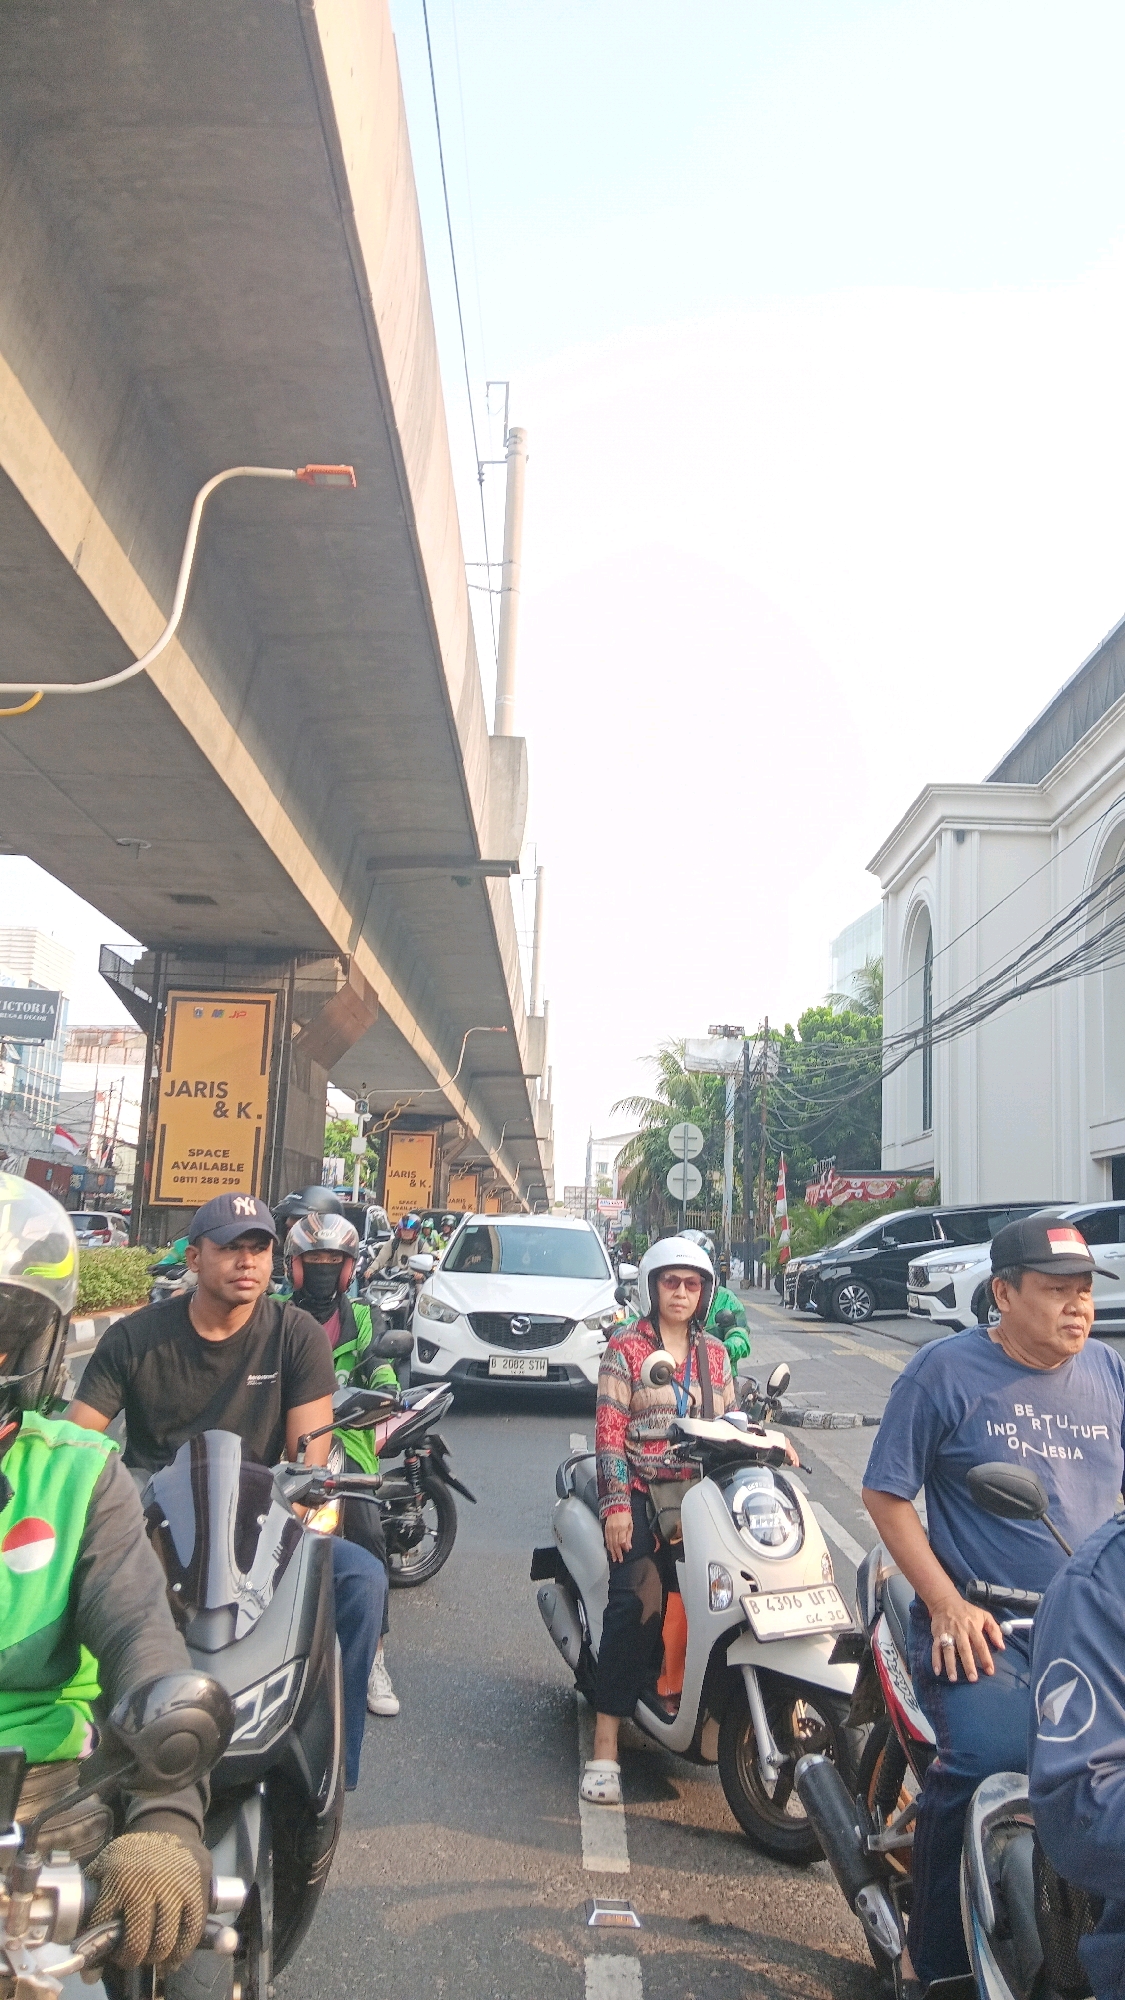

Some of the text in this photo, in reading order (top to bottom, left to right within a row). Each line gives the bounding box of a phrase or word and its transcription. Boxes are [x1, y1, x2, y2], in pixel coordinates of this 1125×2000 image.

[0, 1000, 55, 1015] ICTORIA
[164, 1080, 229, 1099] JARIS
[213, 1100, 229, 1119] &
[188, 1148, 230, 1158] SPACE
[171, 1161, 245, 1172] AVAILABLE
[388, 1170, 417, 1179] JARIS
[221, 1177, 241, 1186] 299
[409, 1179, 417, 1188] &
[491, 1358, 497, 1369] B
[749, 1588, 838, 1614] B 4396 UFD
